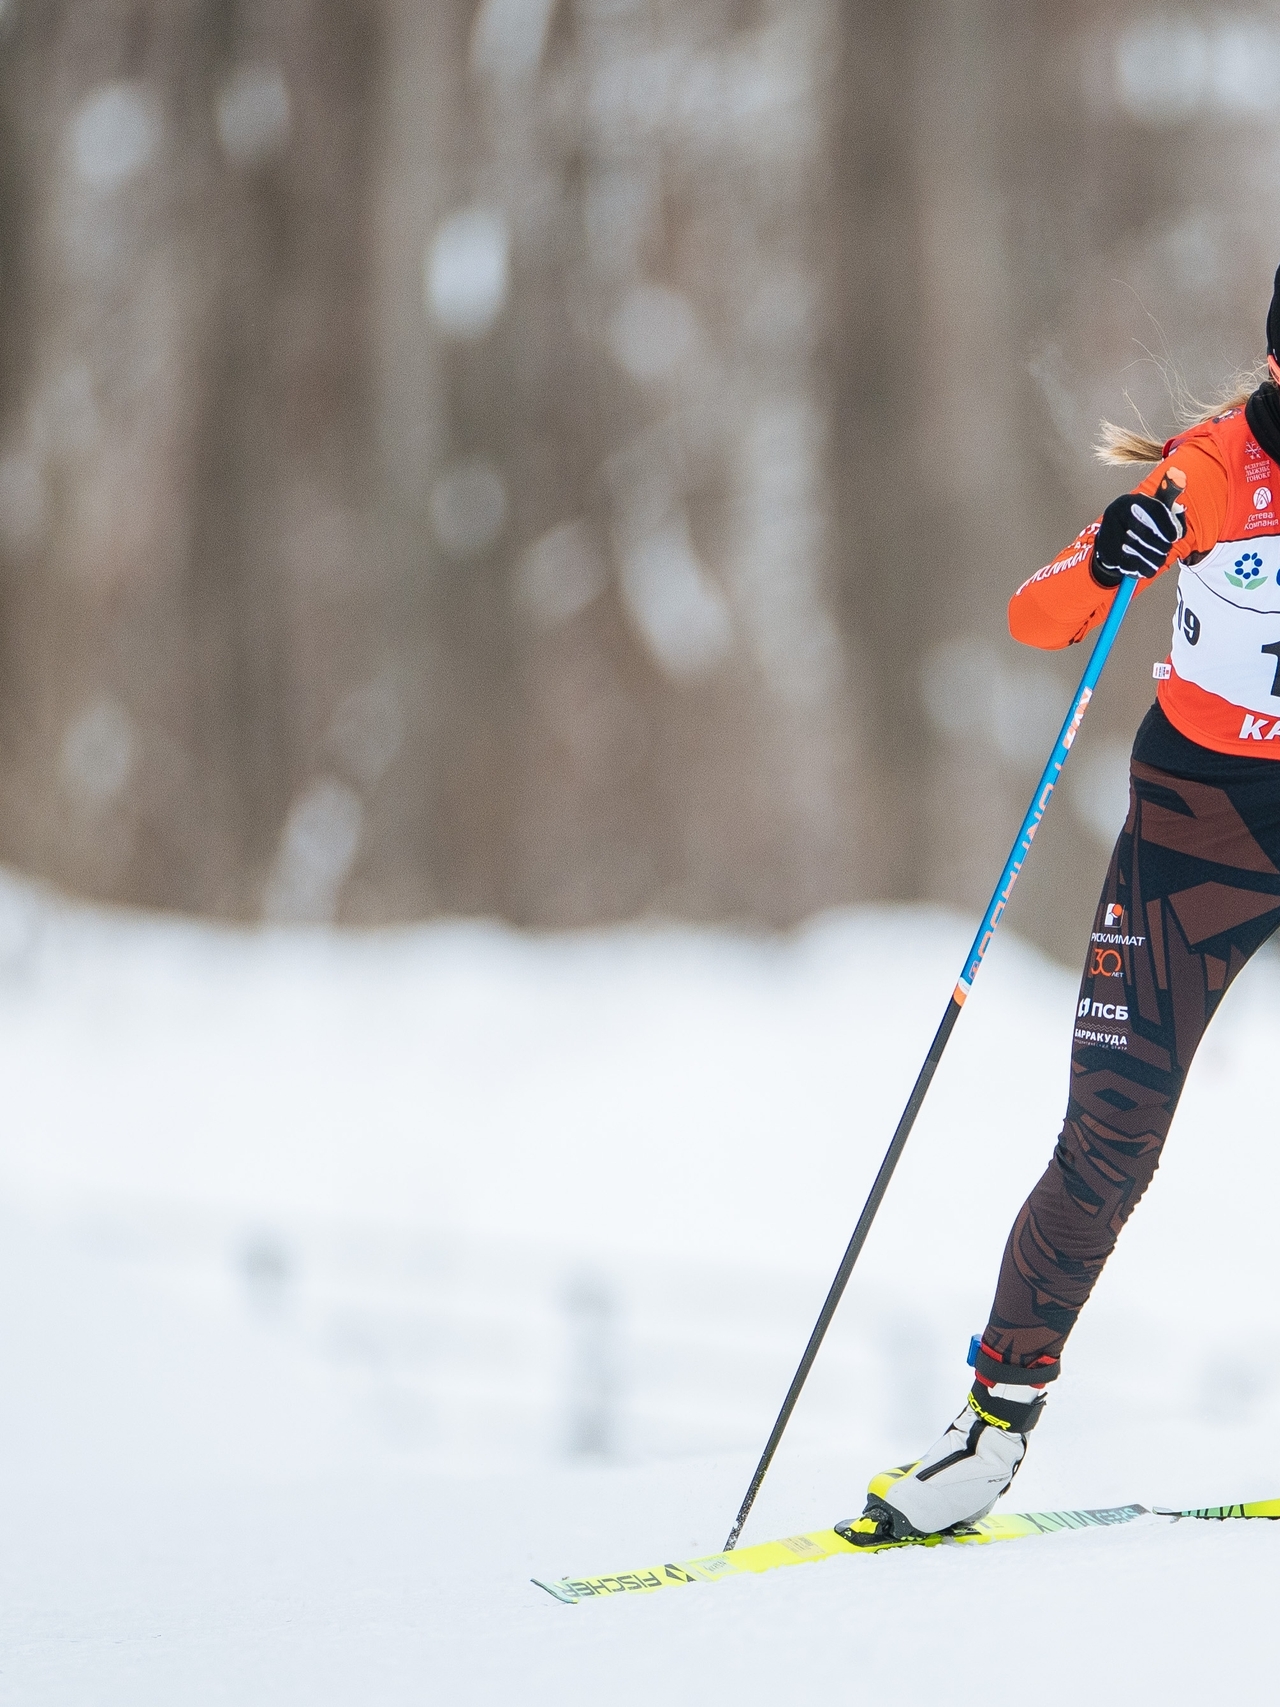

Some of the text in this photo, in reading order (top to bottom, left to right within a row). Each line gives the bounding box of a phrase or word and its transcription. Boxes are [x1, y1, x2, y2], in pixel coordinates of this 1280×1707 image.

[1091, 948, 1122, 977] 30
[1092, 1002, 1129, 1021] ПСБ
[560, 1571, 662, 1598] FISCHER
